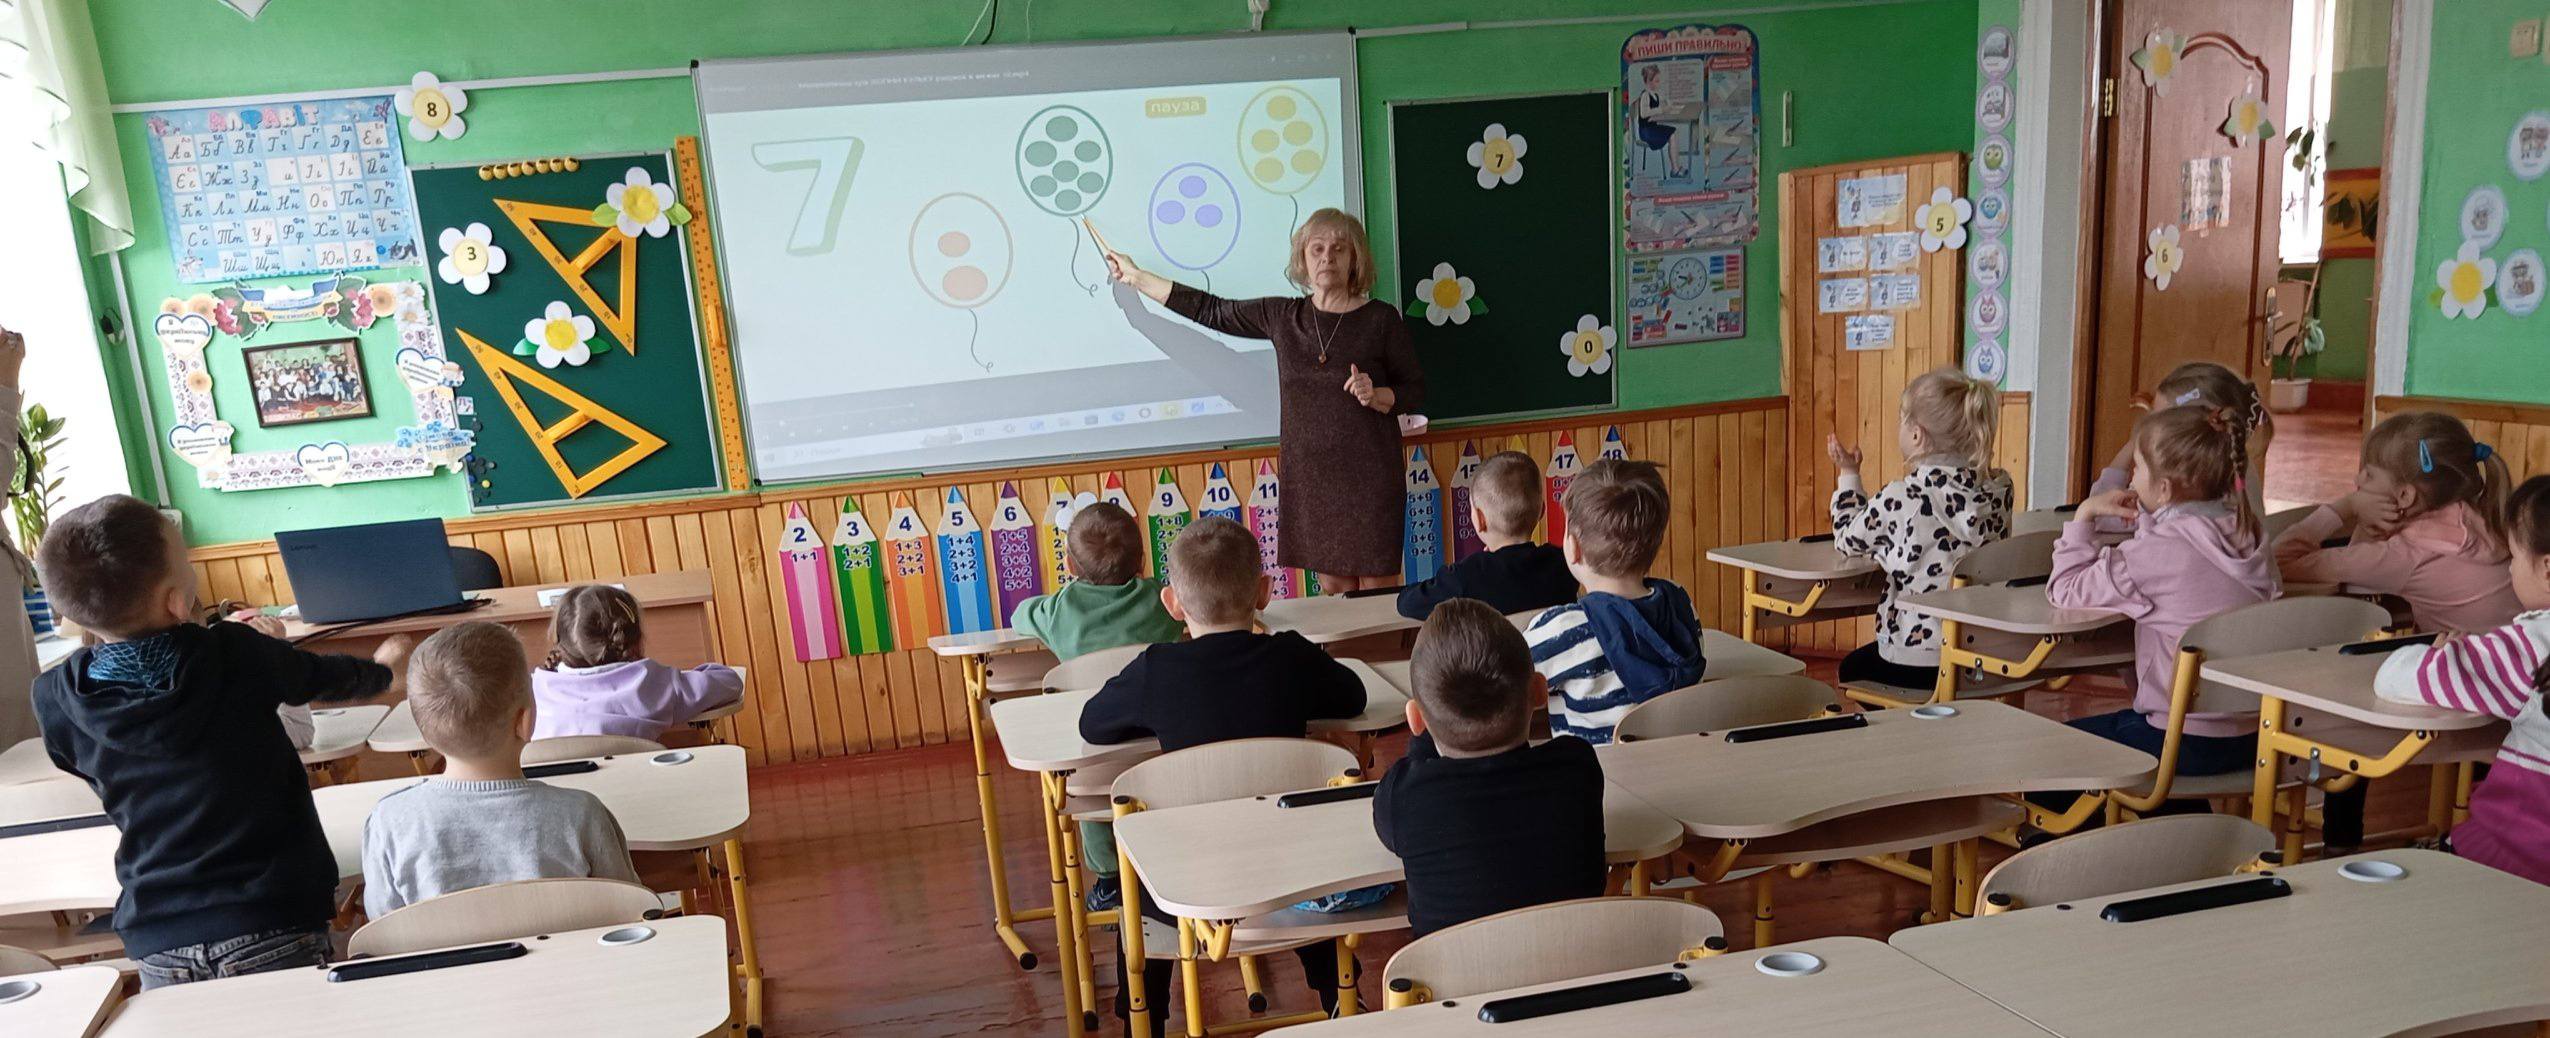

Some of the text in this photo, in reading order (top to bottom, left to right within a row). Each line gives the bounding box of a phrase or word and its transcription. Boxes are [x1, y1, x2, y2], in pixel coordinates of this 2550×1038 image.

[1637, 38, 1743, 57] ПИШИ ПРАВИЛЬНО
[427, 102, 437, 117] 8
[1151, 100, 1200, 113] пауза
[209, 103, 319, 132] АЛФАВІТ
[1495, 153, 1503, 168] 7
[751, 136, 865, 256] 7
[1936, 216, 1944, 232] 5
[467, 246, 476, 261] 3
[2162, 248, 2168, 263] 6
[1584, 340, 1593, 354] 0
[1555, 454, 1574, 469] 17
[1603, 449, 1622, 460] 18
[1409, 469, 1429, 484] 14
[1207, 487, 1230, 502] 10
[1259, 483, 1277, 499] 11
[1161, 492, 1173, 507] 9
[951, 511, 964, 526] 5
[1004, 506, 1017, 521] 6
[900, 516, 912, 531] 4
[1156, 515, 1183, 527] 1+8
[1410, 519, 1434, 530] 7+7
[793, 527, 807, 542] 2
[846, 521, 859, 537] 3
[999, 529, 1028, 543] 1+5
[895, 540, 923, 552] 1+3
[947, 535, 975, 547] 1+4
[1000, 541, 1029, 555] 2+4
[791, 552, 818, 563] 1+1
[843, 545, 872, 557] 1+2
[948, 547, 976, 559] 2+3
[844, 557, 872, 571] 2+1
[897, 553, 924, 565] 2+2
[950, 560, 977, 572] 3+2
[1002, 553, 1031, 567] 3+3
[898, 565, 925, 577] 3+1
[951, 572, 978, 583] 4+1
[1003, 566, 1032, 578] 4+2
[1005, 577, 1032, 590] 5+1
